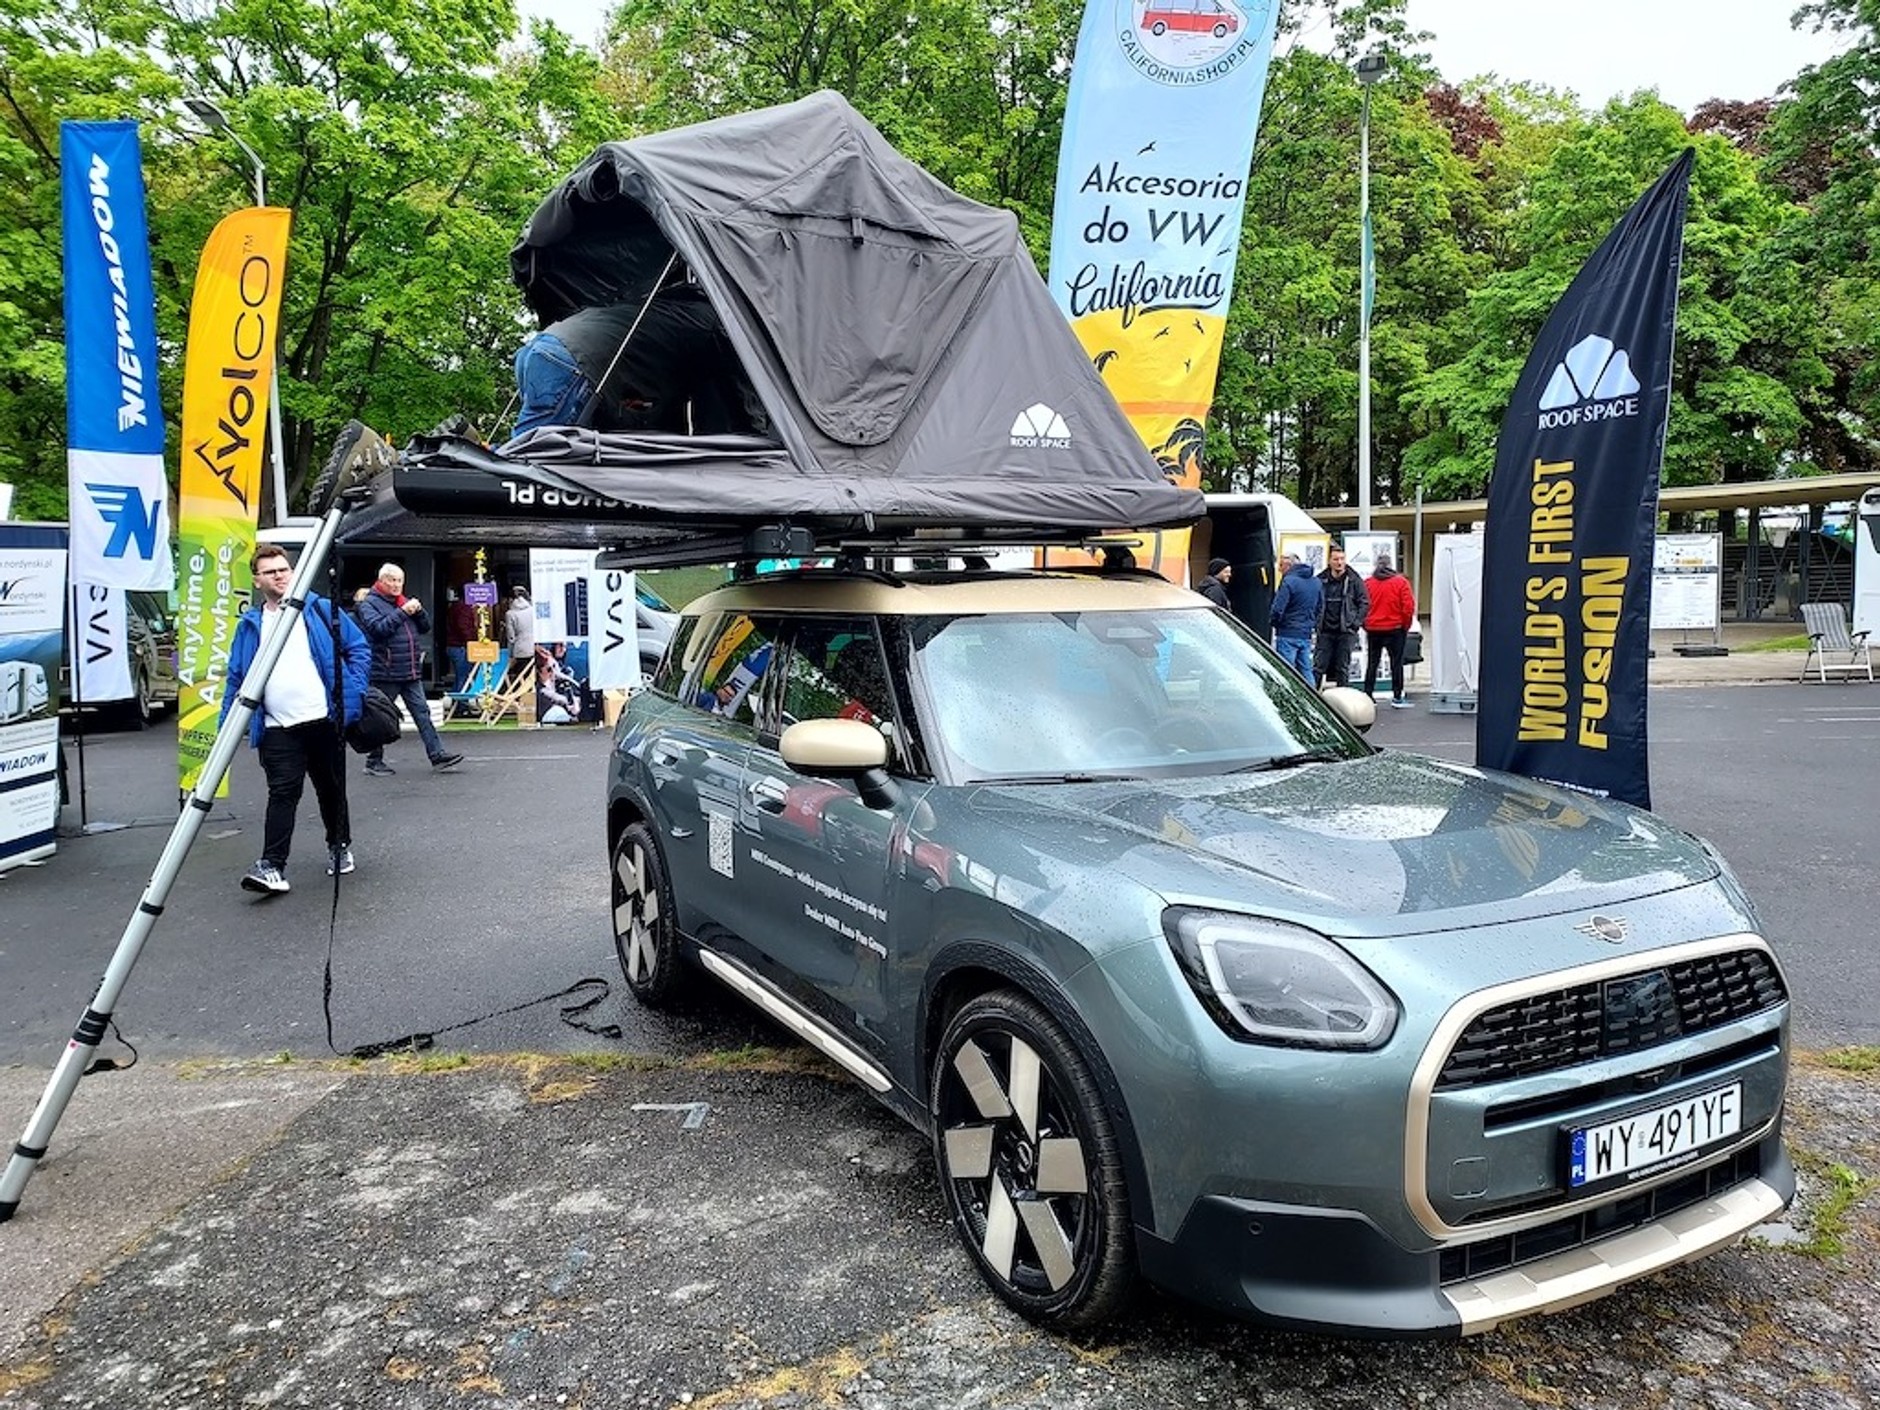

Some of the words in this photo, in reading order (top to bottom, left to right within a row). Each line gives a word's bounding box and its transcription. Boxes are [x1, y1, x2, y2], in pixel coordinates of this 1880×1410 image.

[1119, 29, 1257, 84] CALIFORNIASHOP.PL
[1079, 161, 1243, 199] Akcesoria
[1083, 205, 1129, 243] do
[1148, 208, 1225, 247] VW
[88, 152, 148, 432] NIEWIADOW
[1065, 260, 1225, 329] California
[1538, 408, 1582, 430] ROOF
[1583, 397, 1639, 421] SPACE
[1527, 457, 1577, 565] FIRST
[178, 546, 206, 688] Anytime.
[199, 535, 237, 706] Anywhere.
[1517, 575, 1568, 743] WORLD'S
[1578, 554, 1630, 751] FUSION
[1571, 1164, 1584, 1178] PL
[1595, 1121, 1635, 1175] WY
[1649, 1089, 1734, 1156] 491YF
